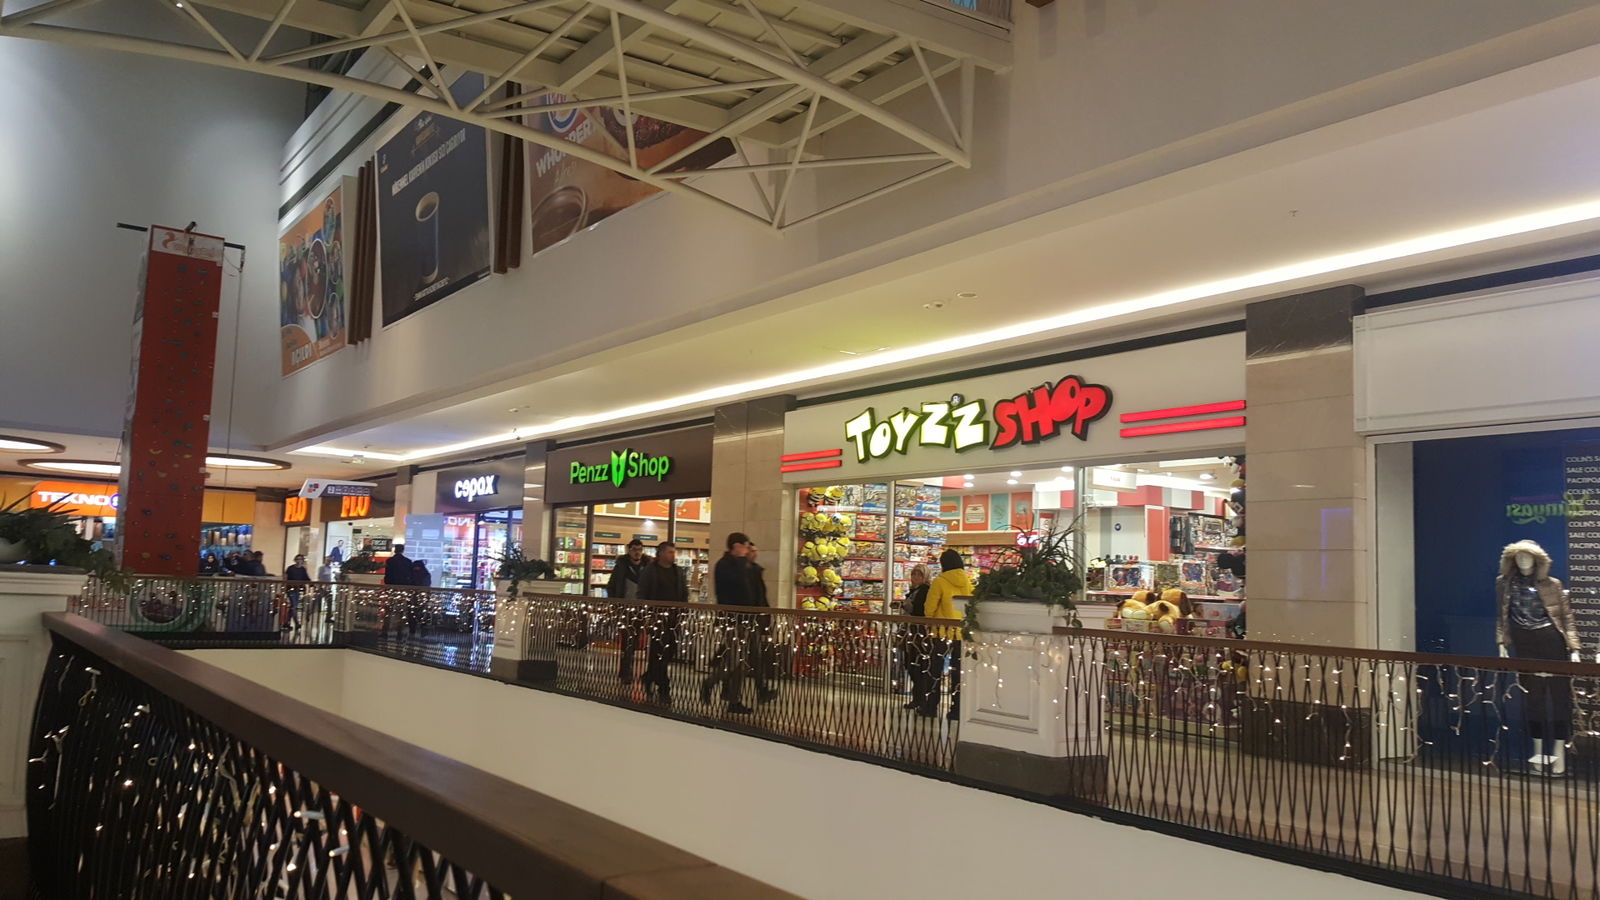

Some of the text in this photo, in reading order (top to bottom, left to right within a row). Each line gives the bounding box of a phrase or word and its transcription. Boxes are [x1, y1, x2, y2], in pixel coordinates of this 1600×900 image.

[989, 375, 1113, 450] SHOP
[569, 451, 670, 485] Penzz Shop
